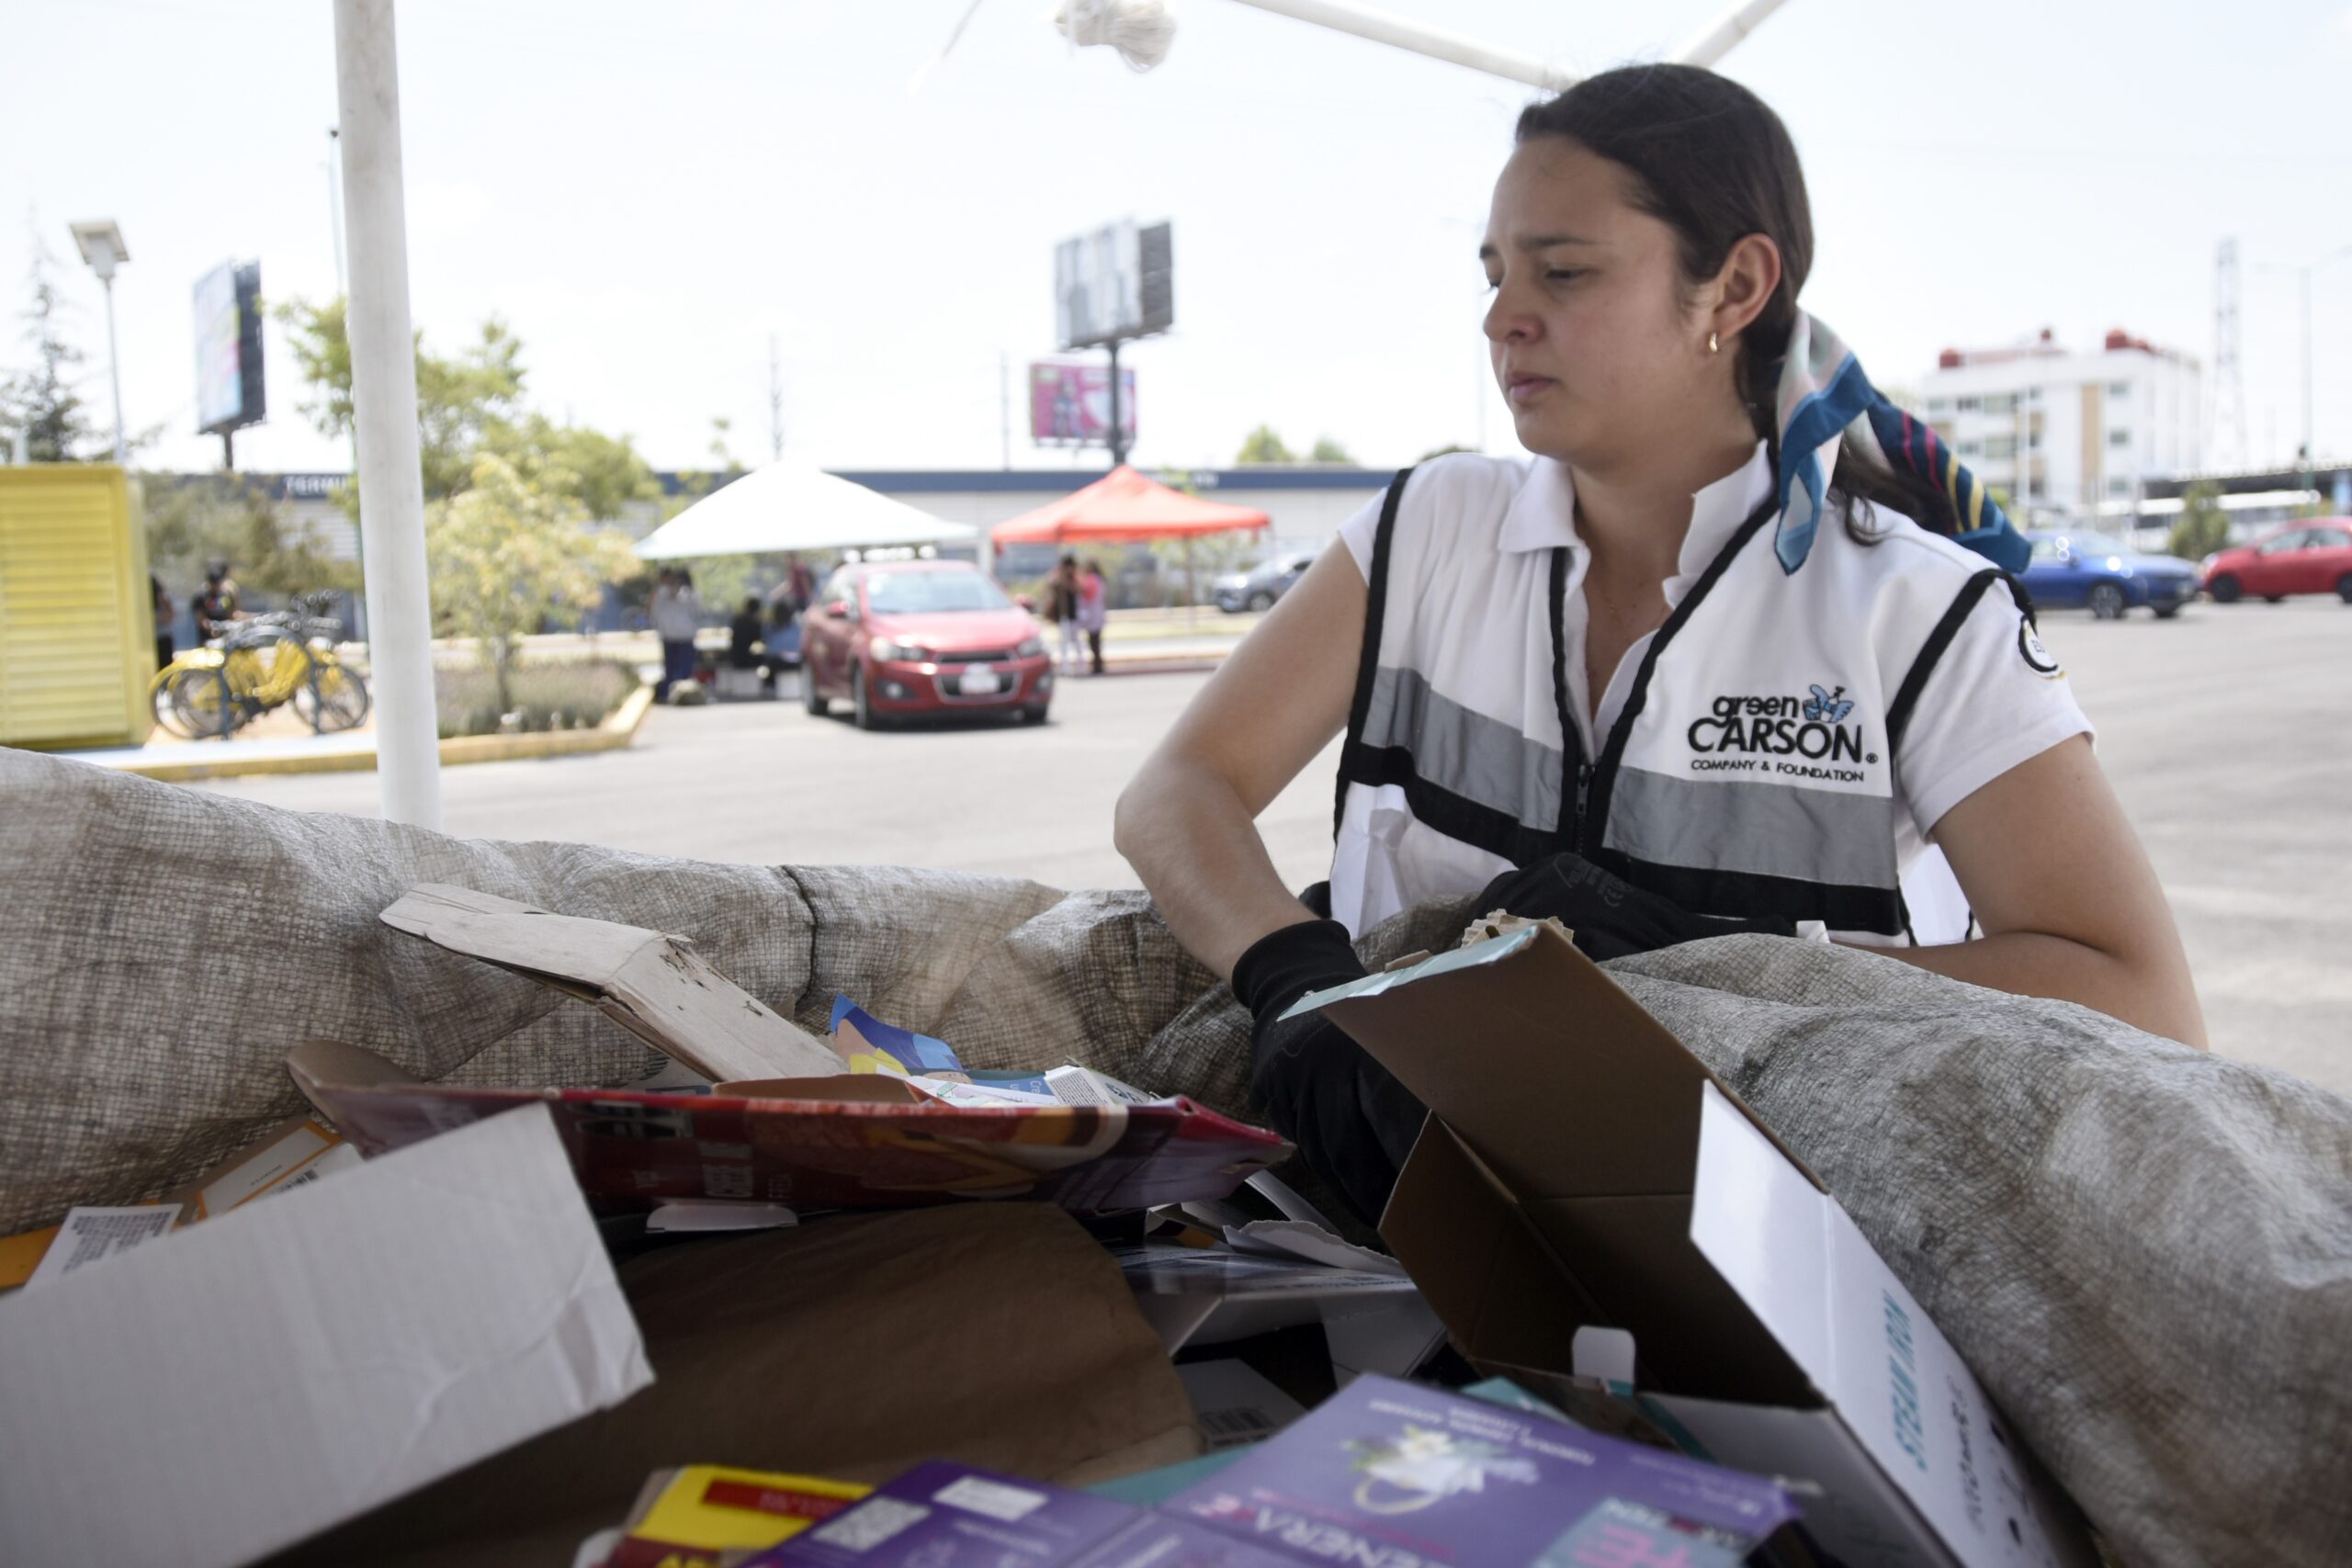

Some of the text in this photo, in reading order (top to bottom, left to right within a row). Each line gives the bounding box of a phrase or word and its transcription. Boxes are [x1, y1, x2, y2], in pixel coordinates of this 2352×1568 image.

[1713, 695, 1799, 728] green
[1690, 760, 1864, 782] COMPANY & FOUNDATION
